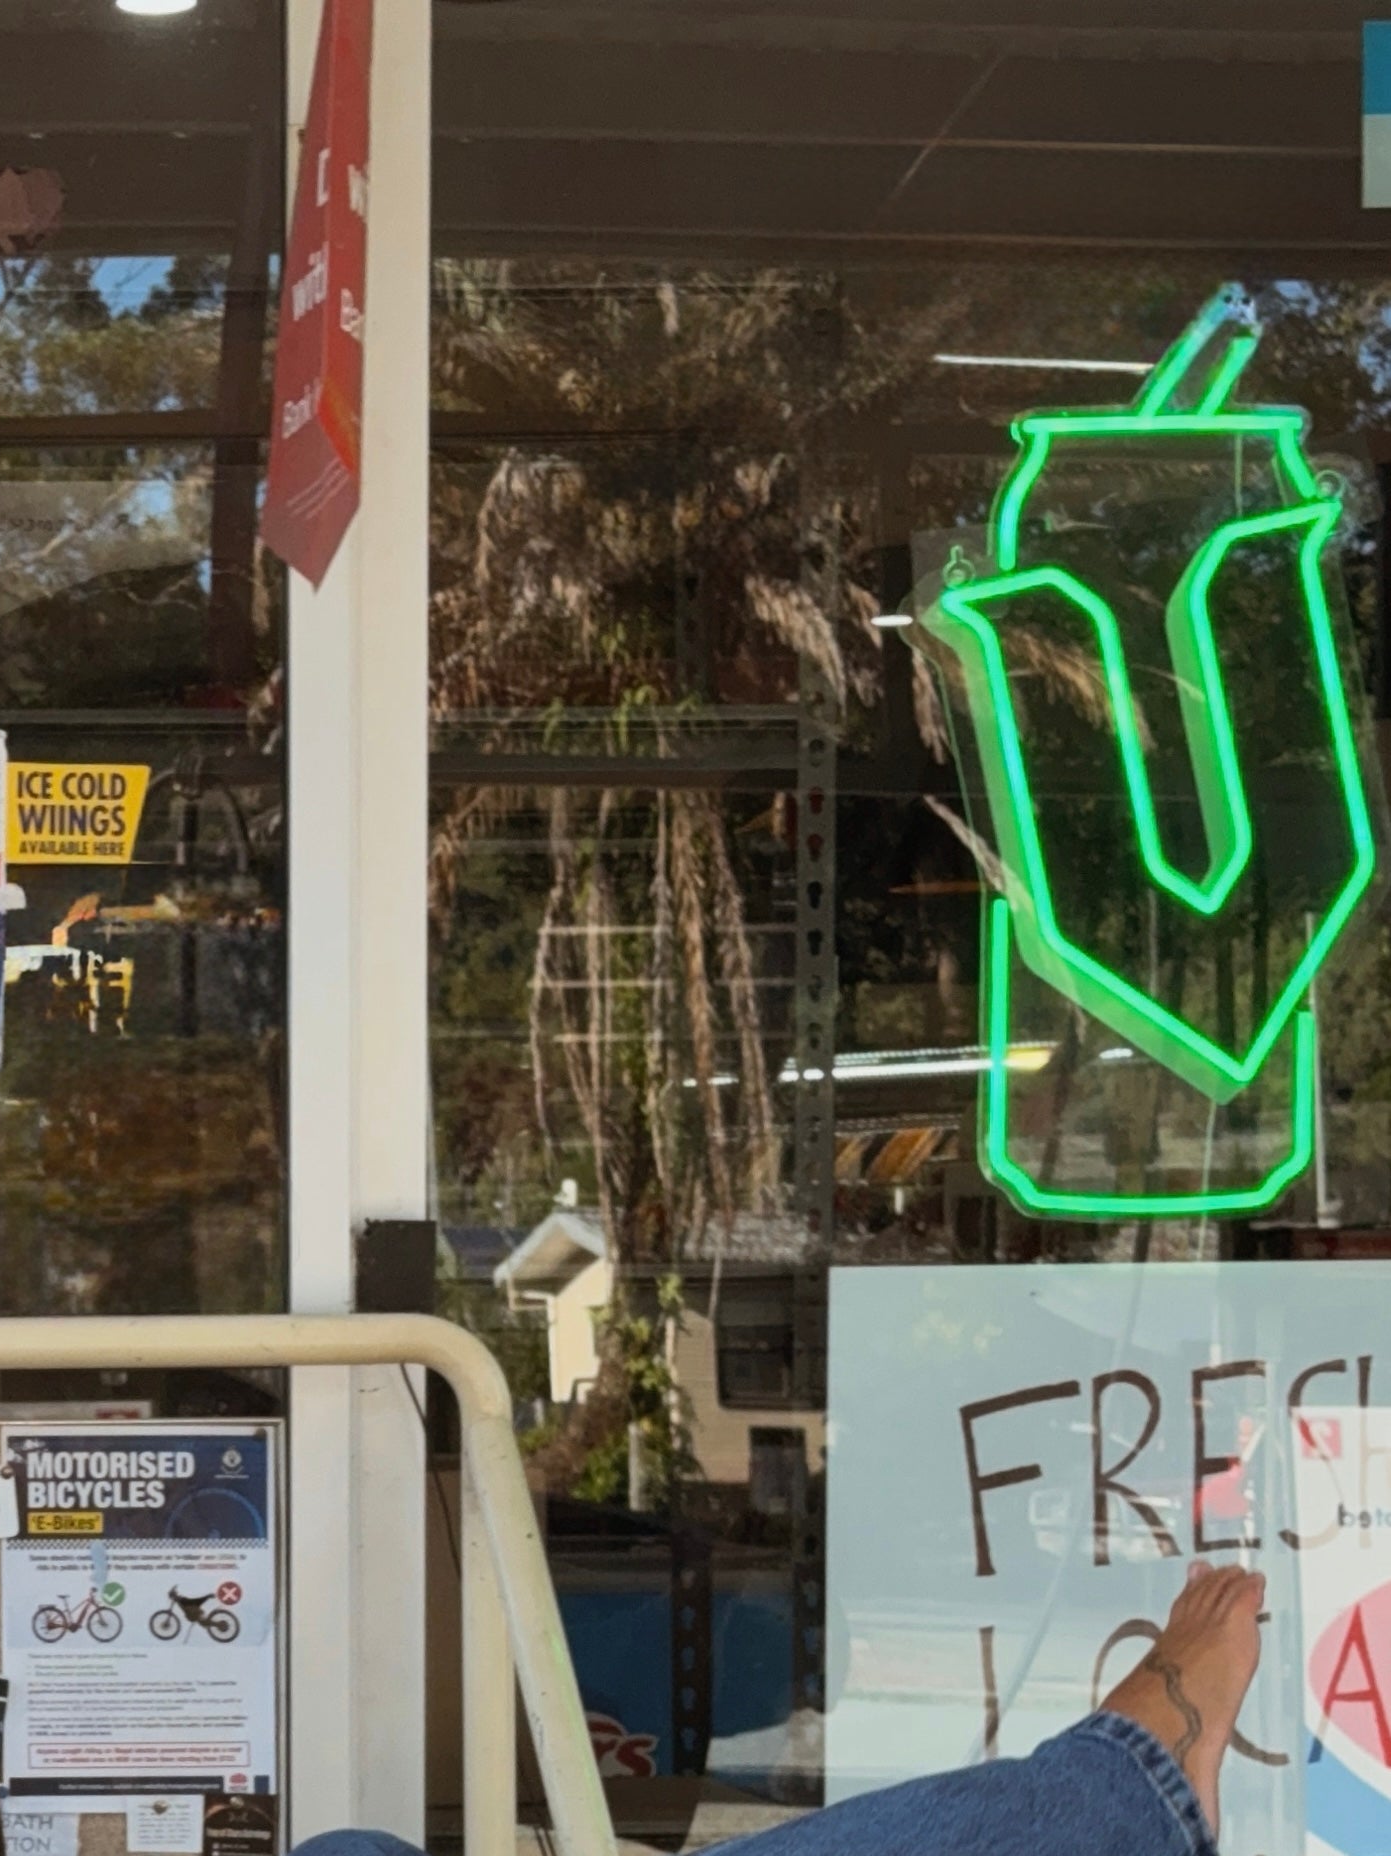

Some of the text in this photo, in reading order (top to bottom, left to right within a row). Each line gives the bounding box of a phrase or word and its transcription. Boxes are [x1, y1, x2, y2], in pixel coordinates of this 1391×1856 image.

[17, 771, 126, 800] ICE COLD
[19, 841, 125, 856] AVAILABLE HERE
[27, 1451, 195, 1479] MOTORISED
[27, 1481, 166, 1508] BICYCLES
